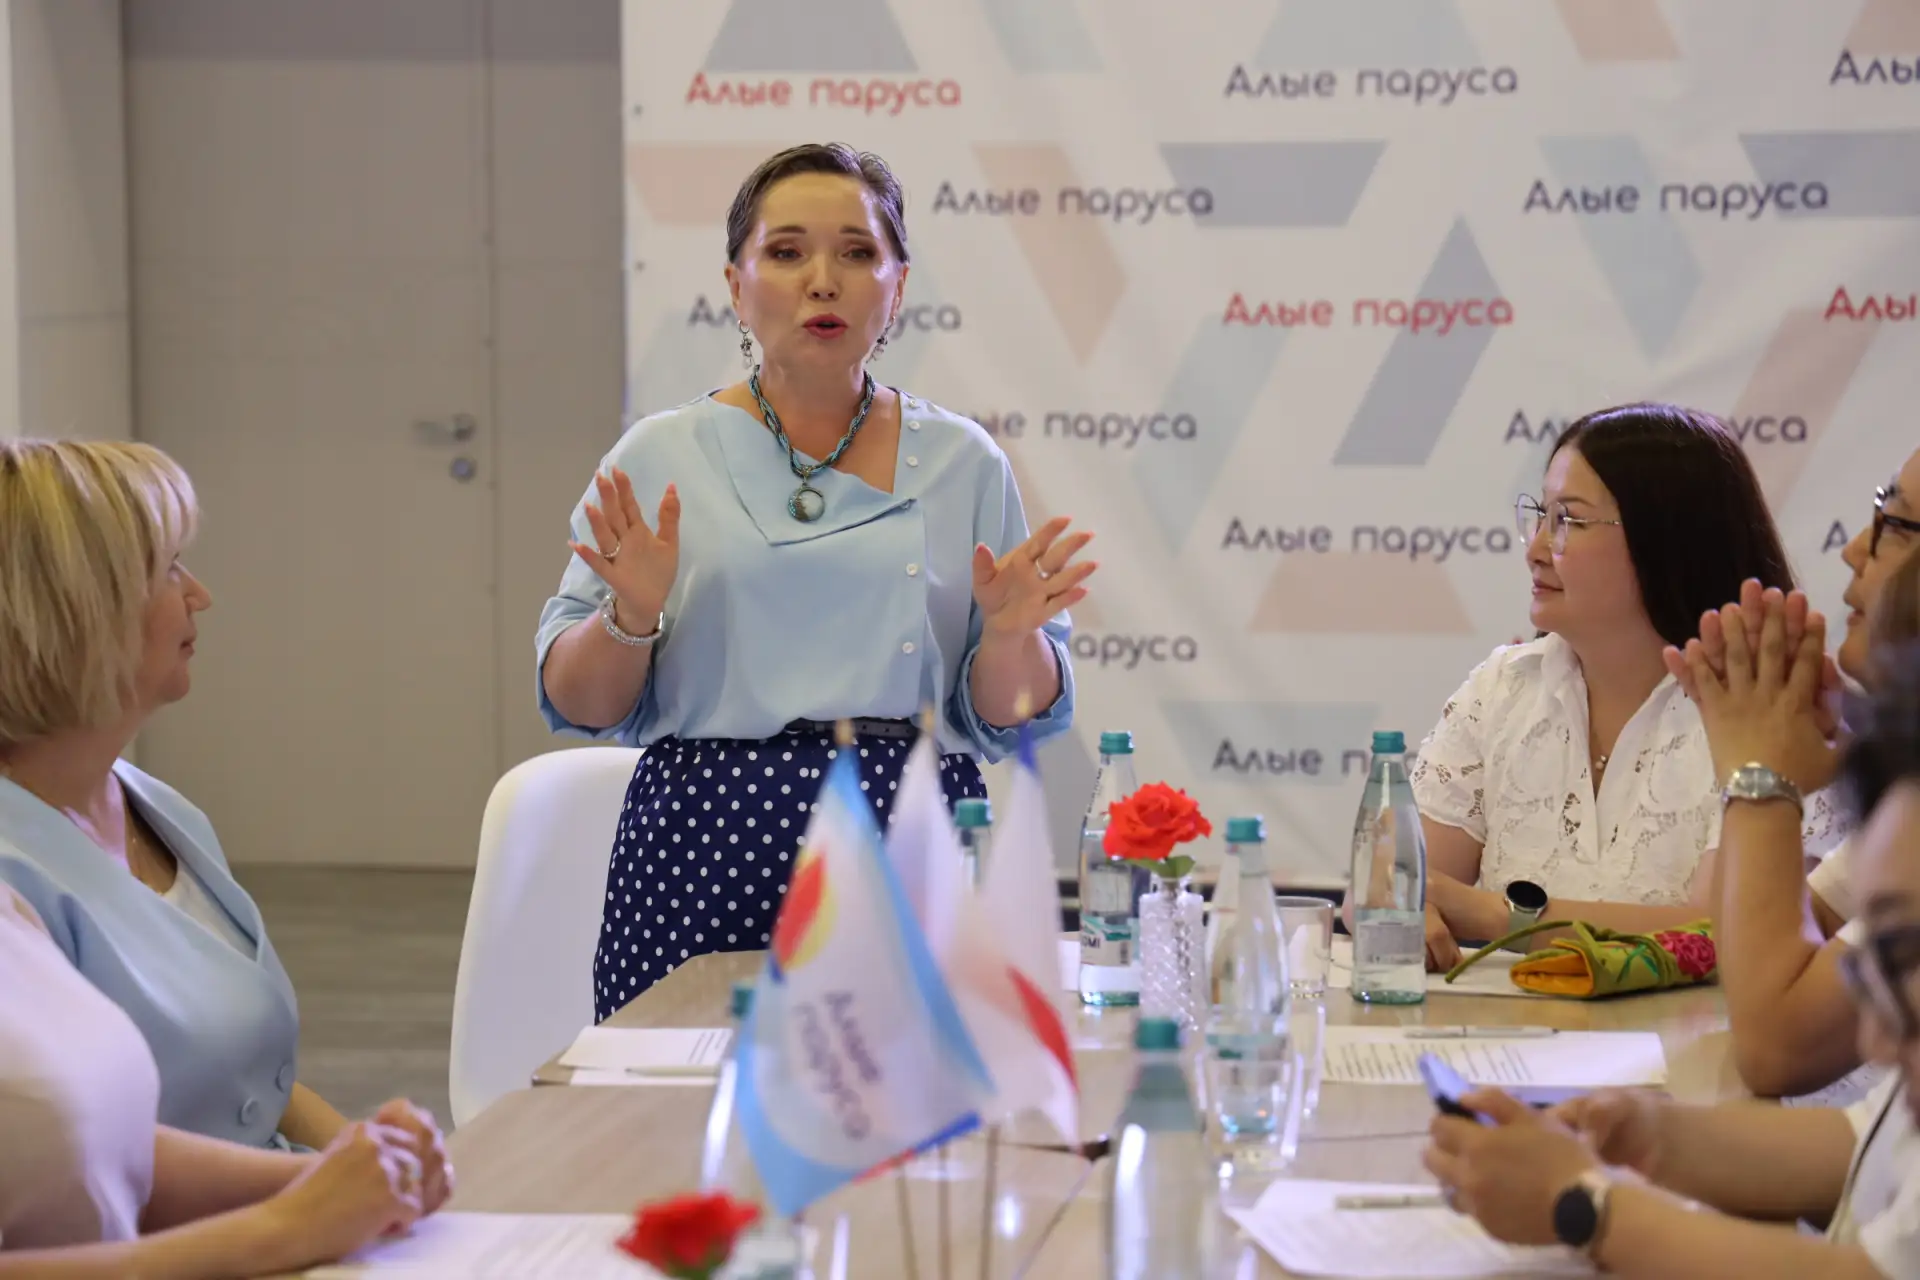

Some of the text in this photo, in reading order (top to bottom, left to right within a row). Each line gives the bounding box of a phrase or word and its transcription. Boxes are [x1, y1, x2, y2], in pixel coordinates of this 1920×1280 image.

[1224, 63, 1518, 106] Алые паруса
[1829, 47, 1920, 86] Алы
[685, 71, 961, 116] Алые паруса
[931, 181, 1215, 225] Алые паруса
[1523, 179, 1829, 220] Алые паруса
[687, 294, 962, 339] Ал уса
[1222, 292, 1513, 337] Алые паруса
[1823, 285, 1917, 323] Алы
[1044, 412, 1197, 448] паруса
[1504, 408, 1808, 444] Ал уса
[1220, 515, 1512, 563] Алые паруса
[1074, 632, 1198, 671] аруса
[1212, 737, 1324, 776] Алые
